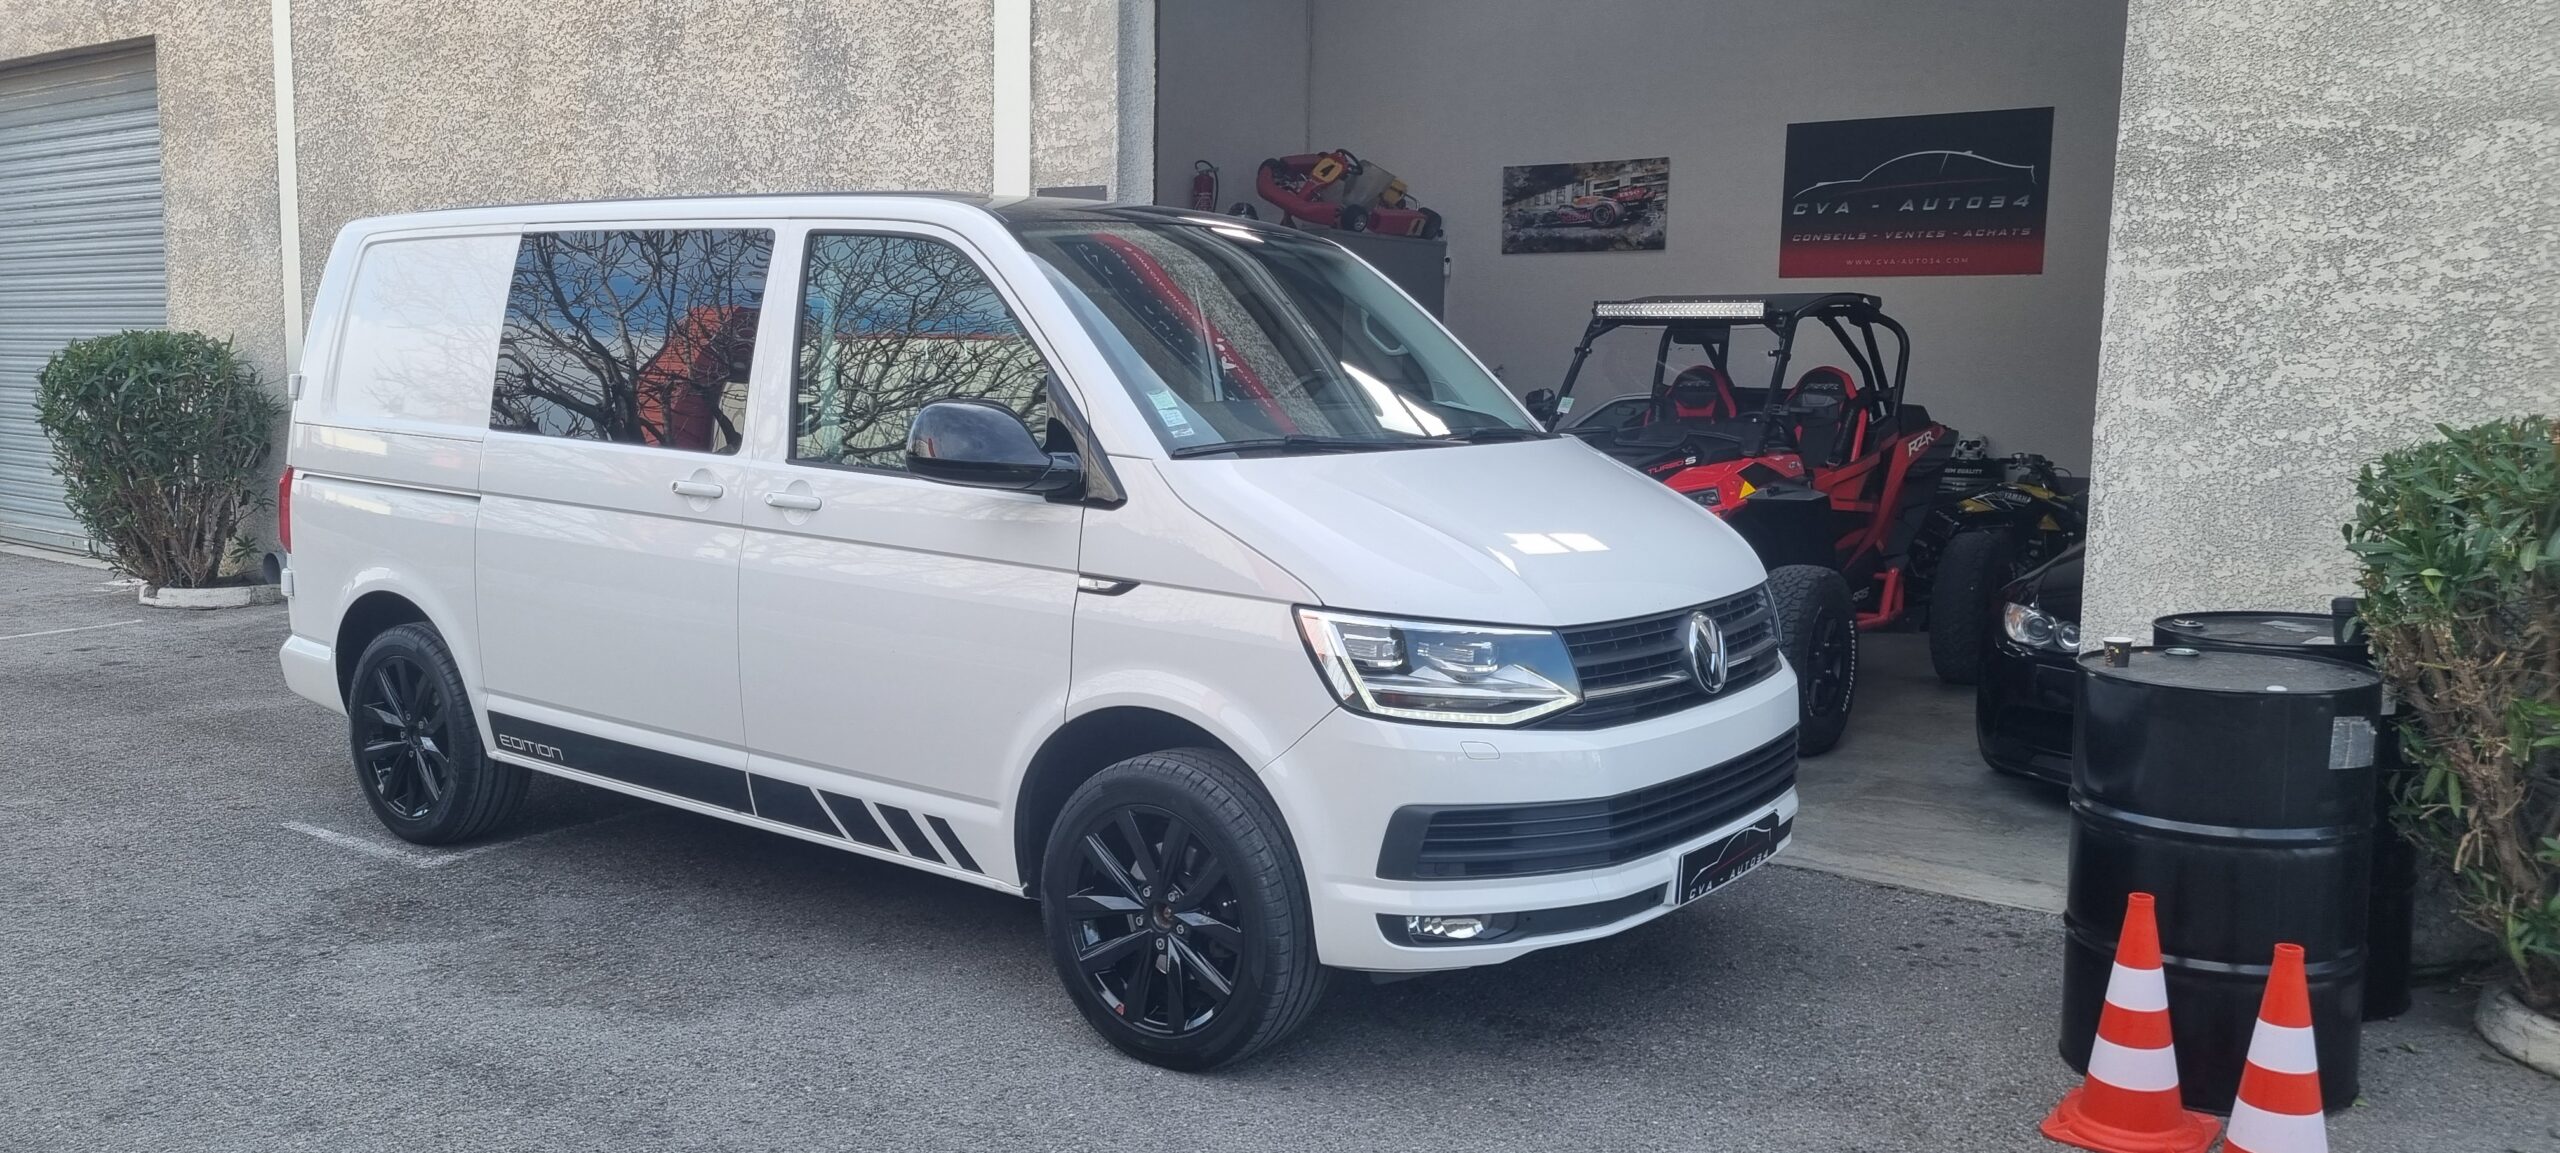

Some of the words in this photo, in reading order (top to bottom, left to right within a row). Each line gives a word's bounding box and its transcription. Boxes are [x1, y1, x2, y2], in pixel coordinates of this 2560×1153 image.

[1793, 202, 1850, 215] CVA
[1898, 194, 2031, 212] AUTO34
[1792, 231, 1867, 242] CONSEILS
[1885, 229, 1946, 240] VENTES
[1962, 227, 2032, 238] ACHATS
[1908, 430, 1935, 457] RZR
[1647, 458, 1684, 474] TURBO
[1684, 456, 1697, 465] S
[2003, 491, 2032, 505] YAMAHA
[499, 733, 564, 761] EDITION
[1689, 880, 1713, 900] CVA
[1729, 849, 1769, 881] AUTO34
